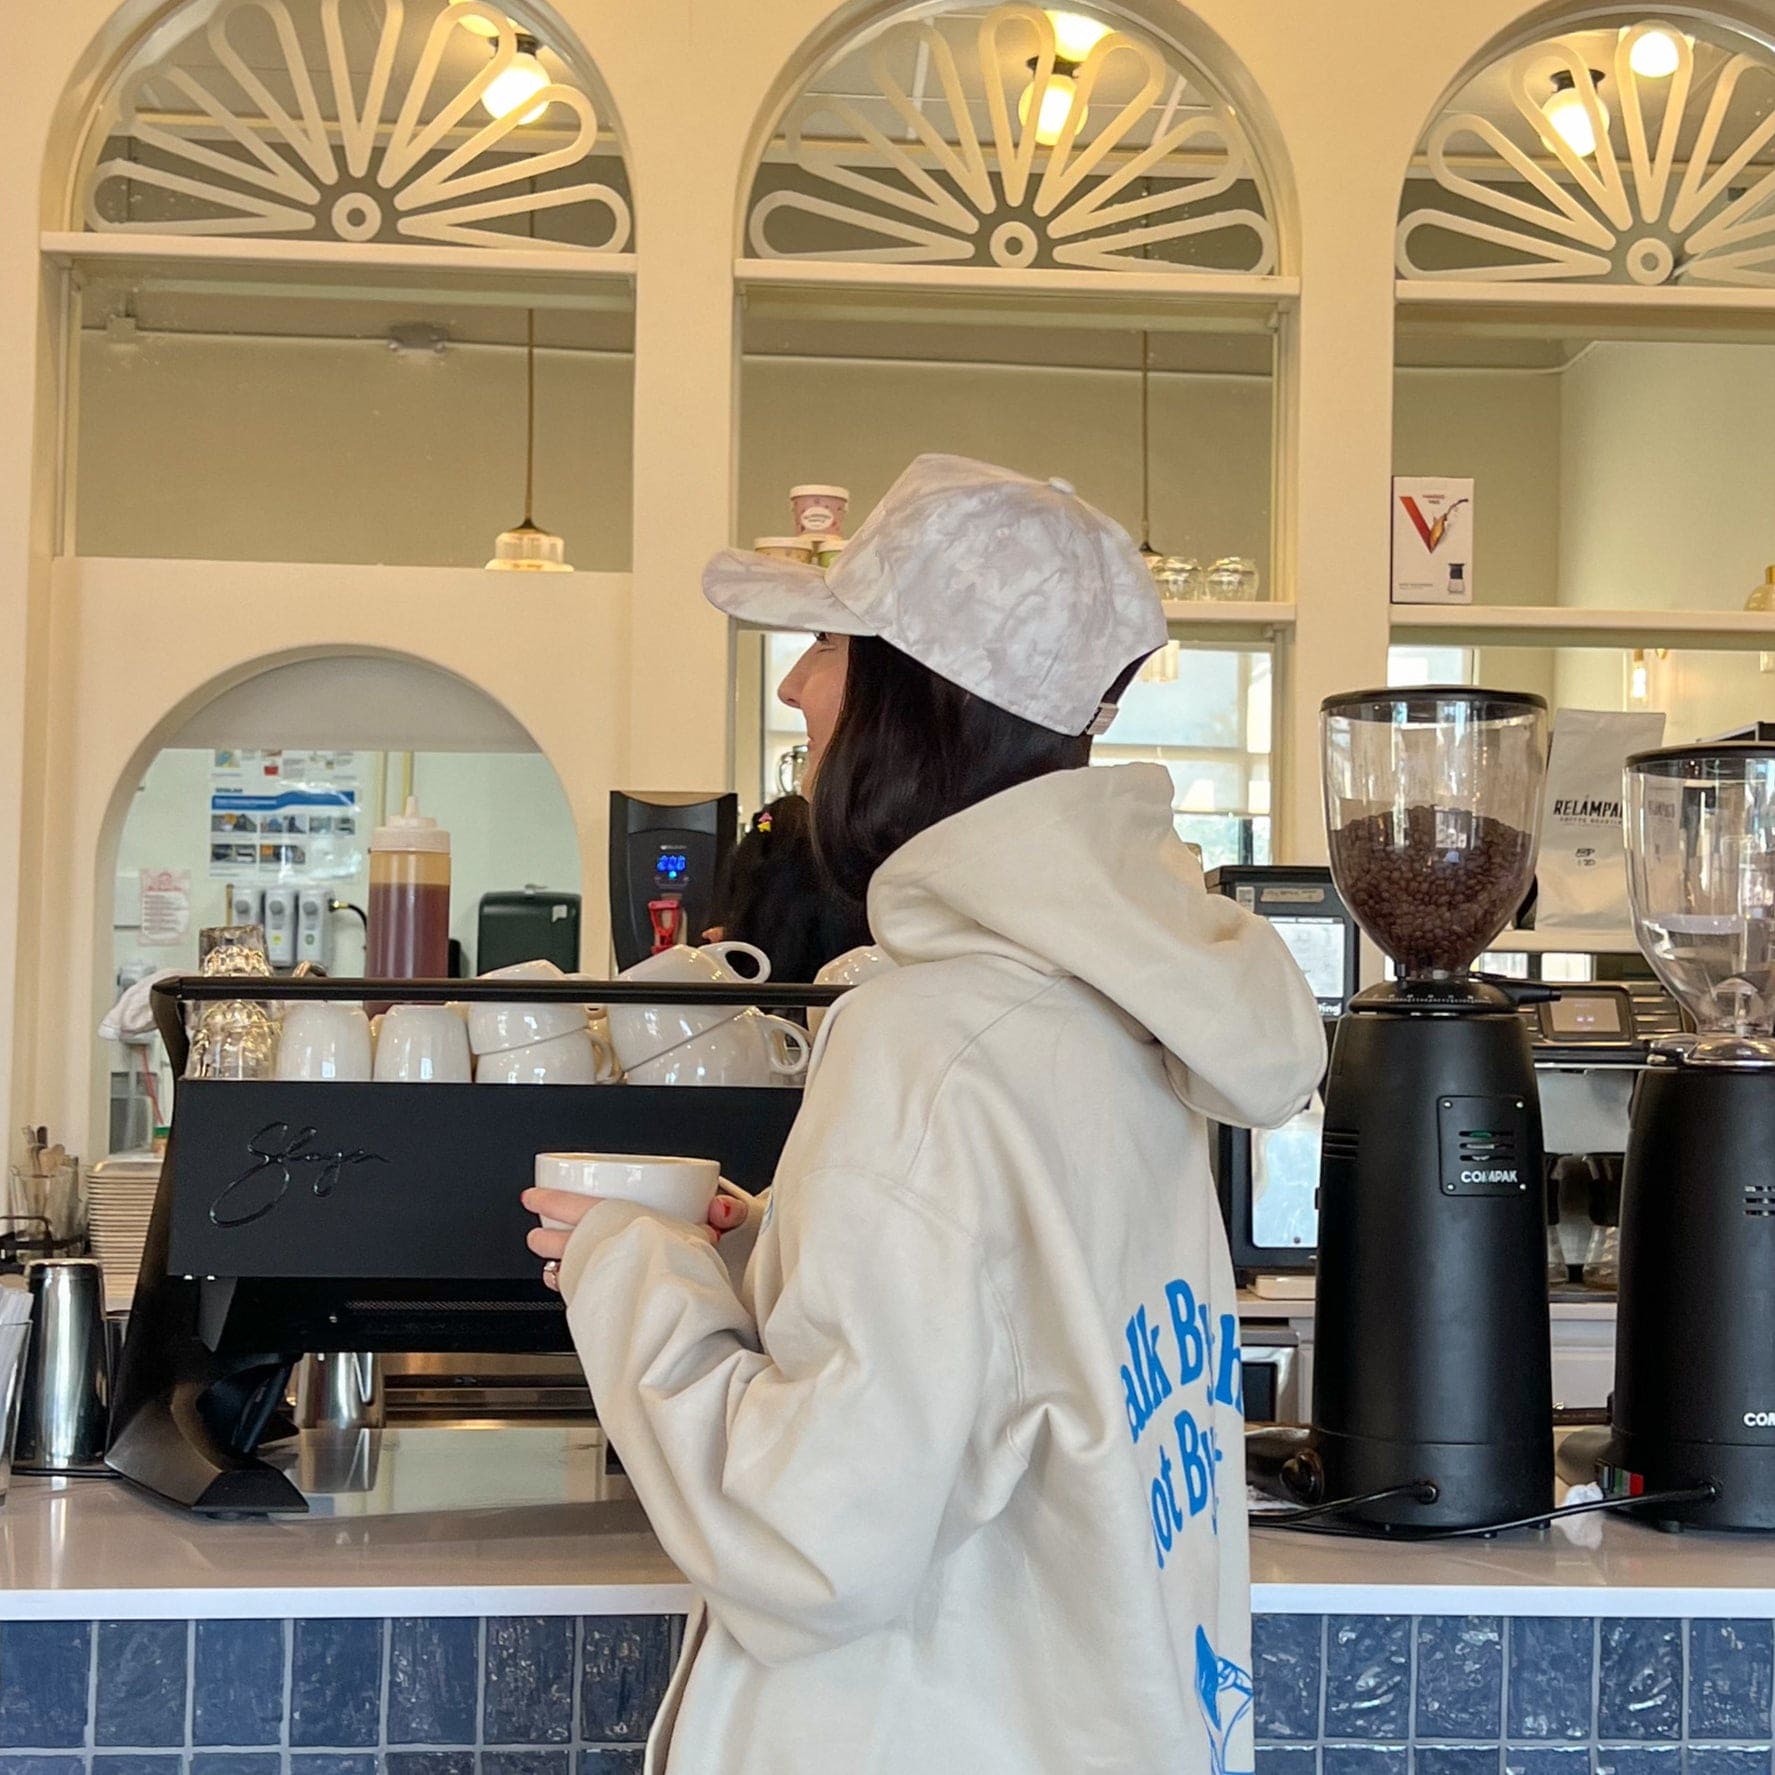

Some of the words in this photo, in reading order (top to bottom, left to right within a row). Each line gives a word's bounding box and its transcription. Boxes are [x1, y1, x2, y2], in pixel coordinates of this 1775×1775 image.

[1460, 1170, 1518, 1183] COMPAK
[1120, 1303, 1173, 1444] alk
[1151, 1445, 1183, 1569] ot
